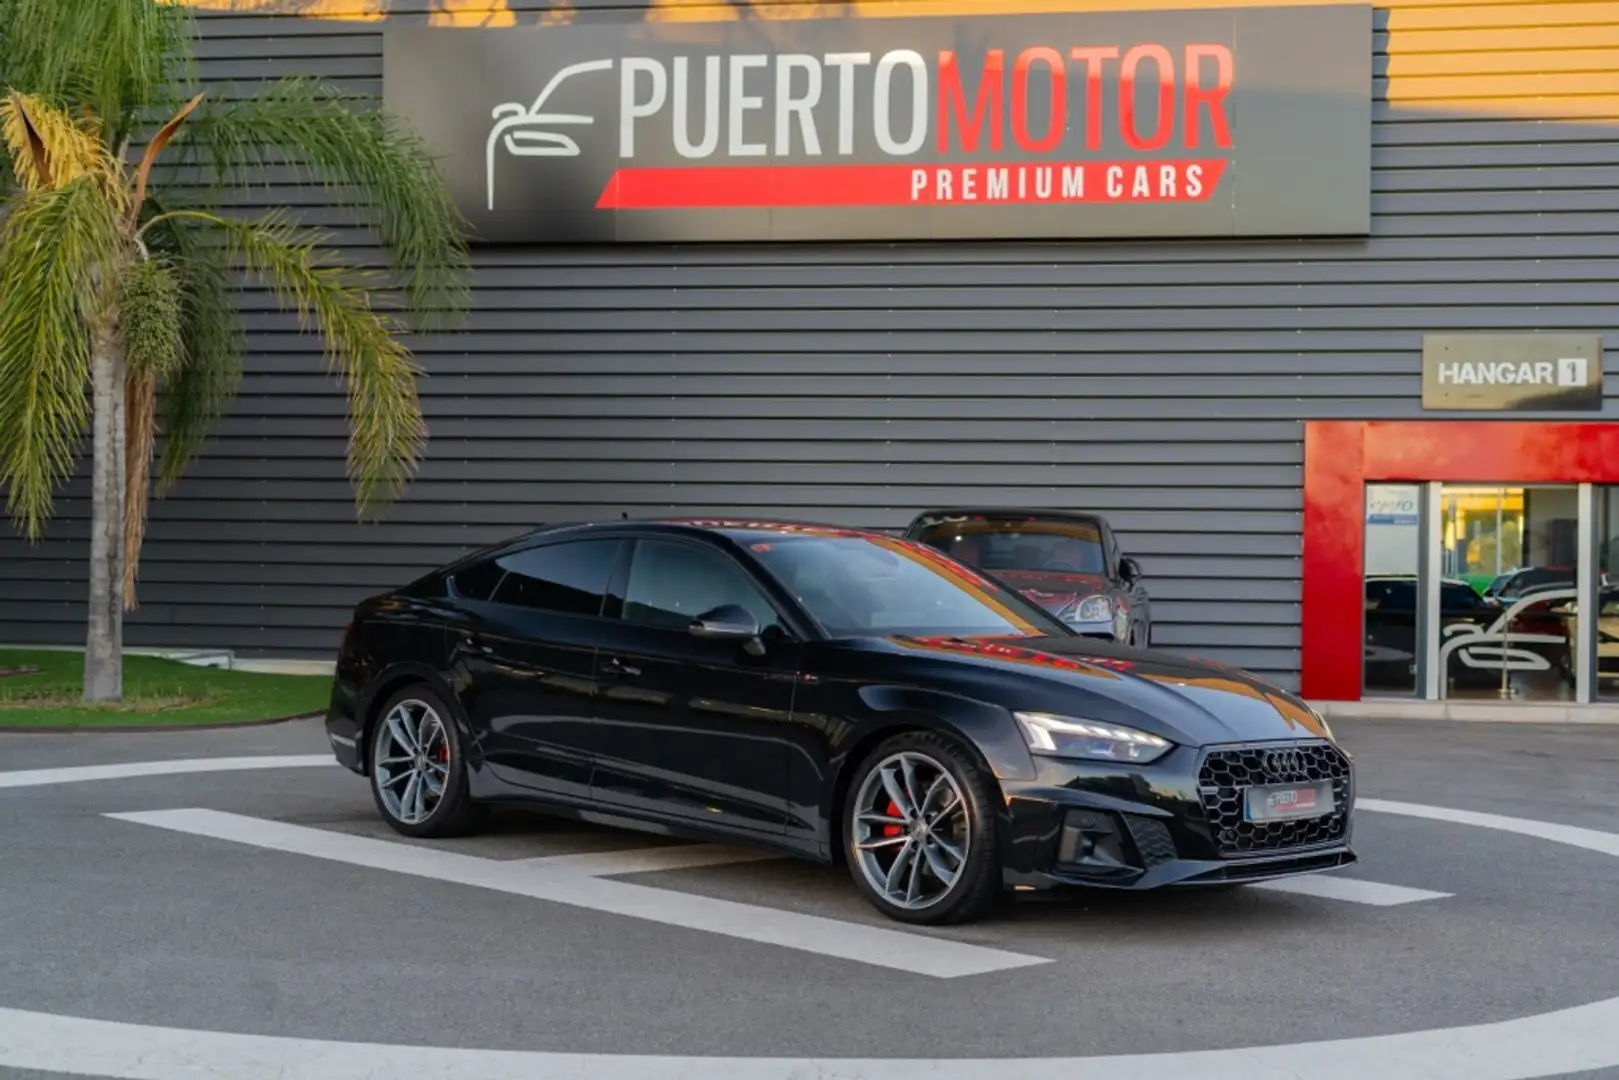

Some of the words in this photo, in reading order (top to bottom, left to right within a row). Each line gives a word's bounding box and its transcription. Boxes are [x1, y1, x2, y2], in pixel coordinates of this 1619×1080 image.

[911, 166, 1084, 200] PREMIUM
[1106, 164, 1203, 198] CARS
[1438, 362, 1554, 384] HANGAR
